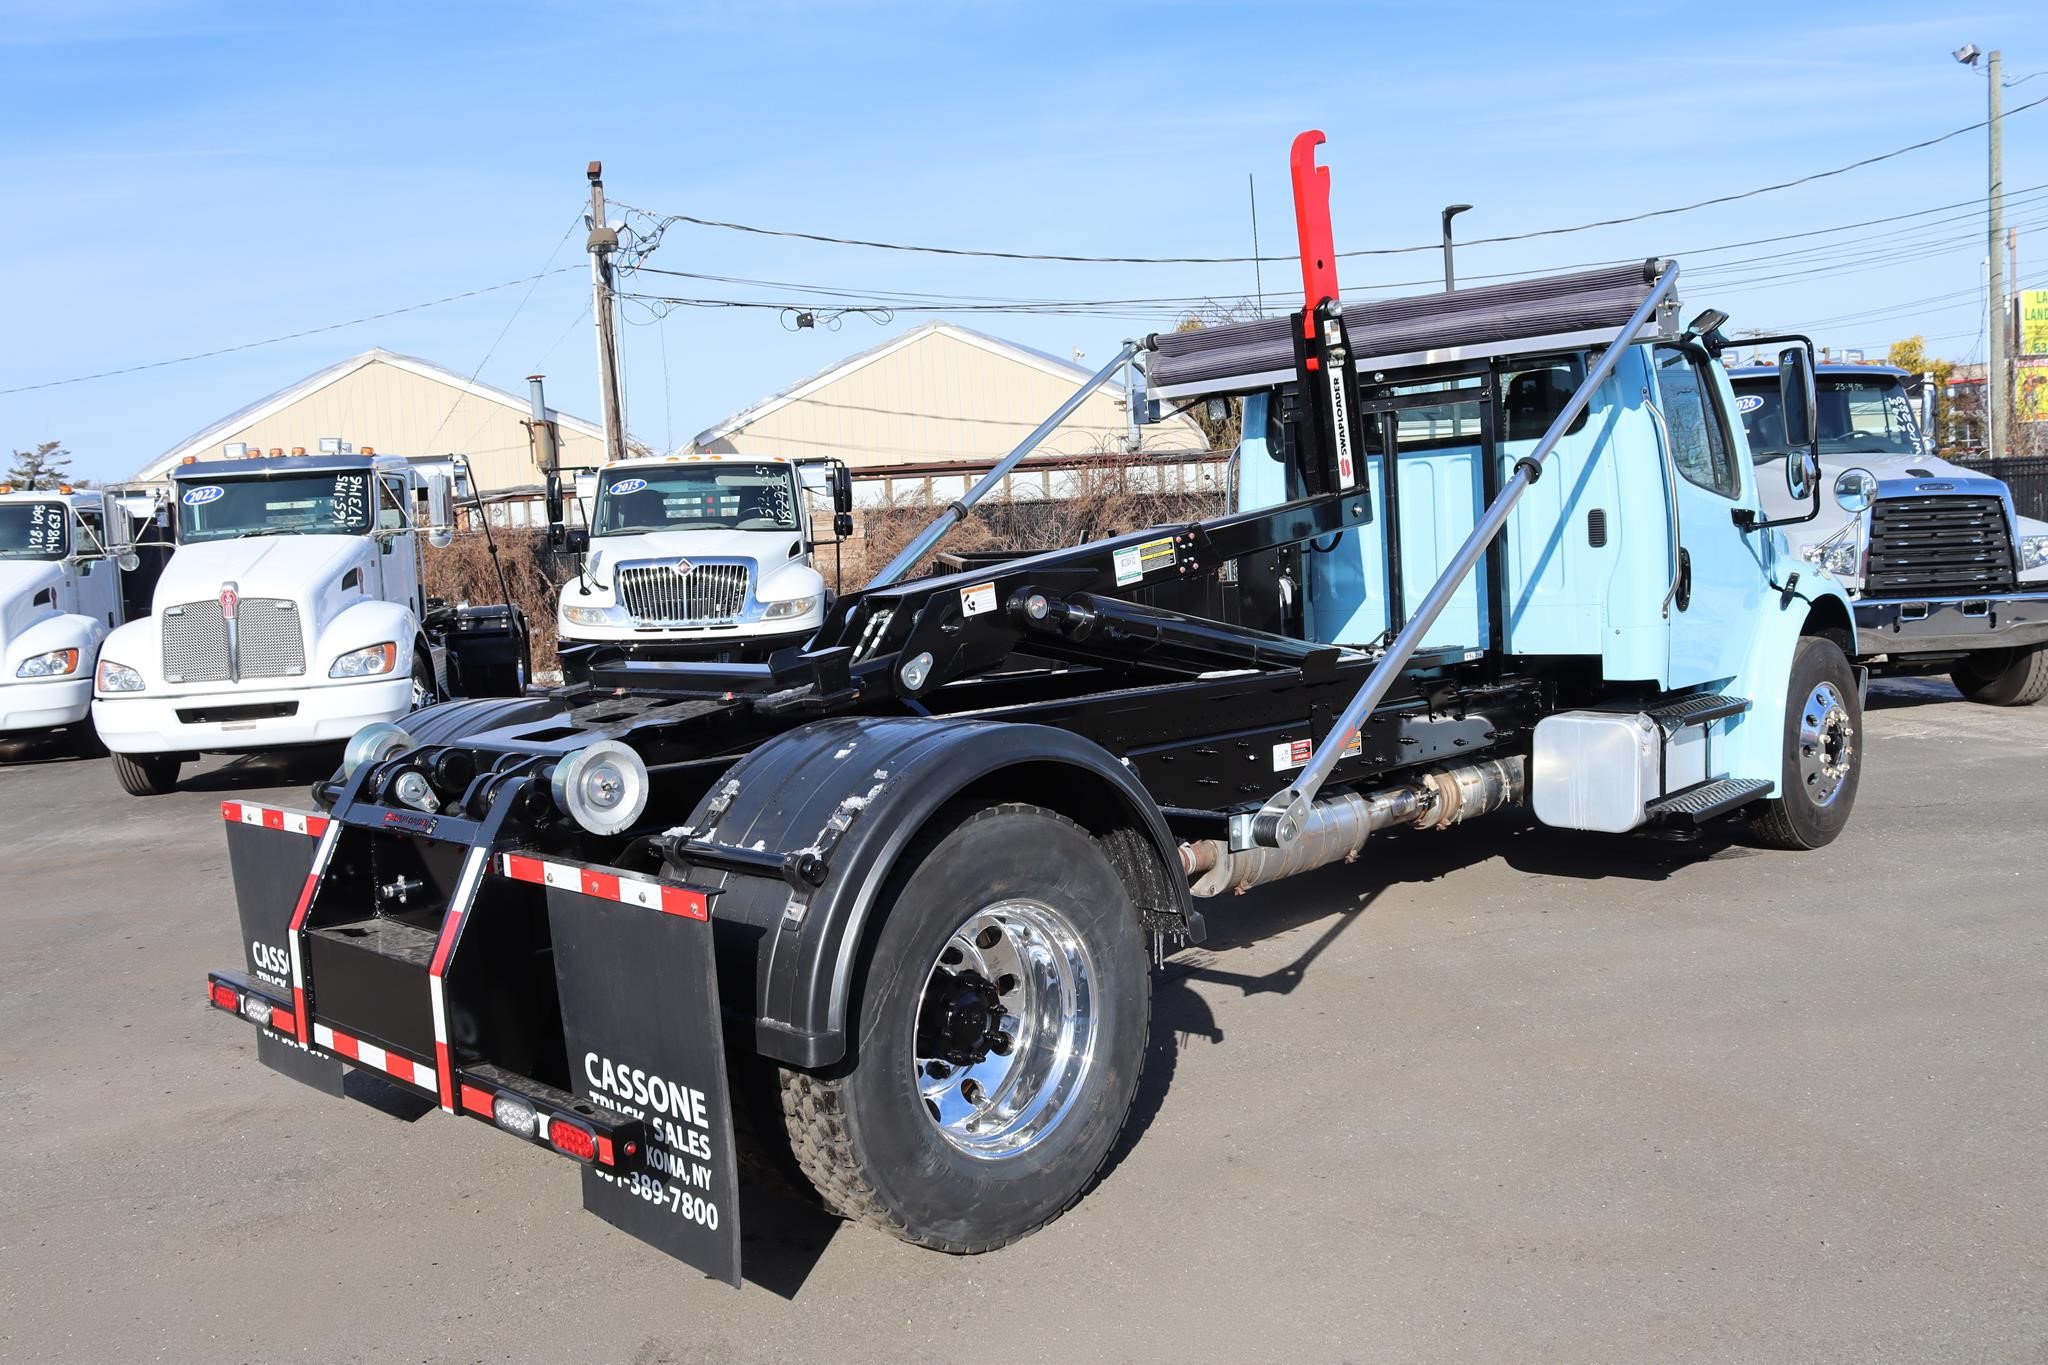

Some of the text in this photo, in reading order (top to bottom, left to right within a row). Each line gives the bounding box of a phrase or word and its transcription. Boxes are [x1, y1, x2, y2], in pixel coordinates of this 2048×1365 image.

[1333, 377, 1348, 456] SWAPLOADER
[188, 488, 217, 503] 2022
[347, 476, 363, 526] 473146
[614, 480, 641, 494] 2015
[46, 509, 62, 552] 448631
[252, 941, 291, 976] CASS
[584, 1052, 709, 1129] CASSONE
[652, 1116, 712, 1161] SALES
[691, 1162, 712, 1192] NY
